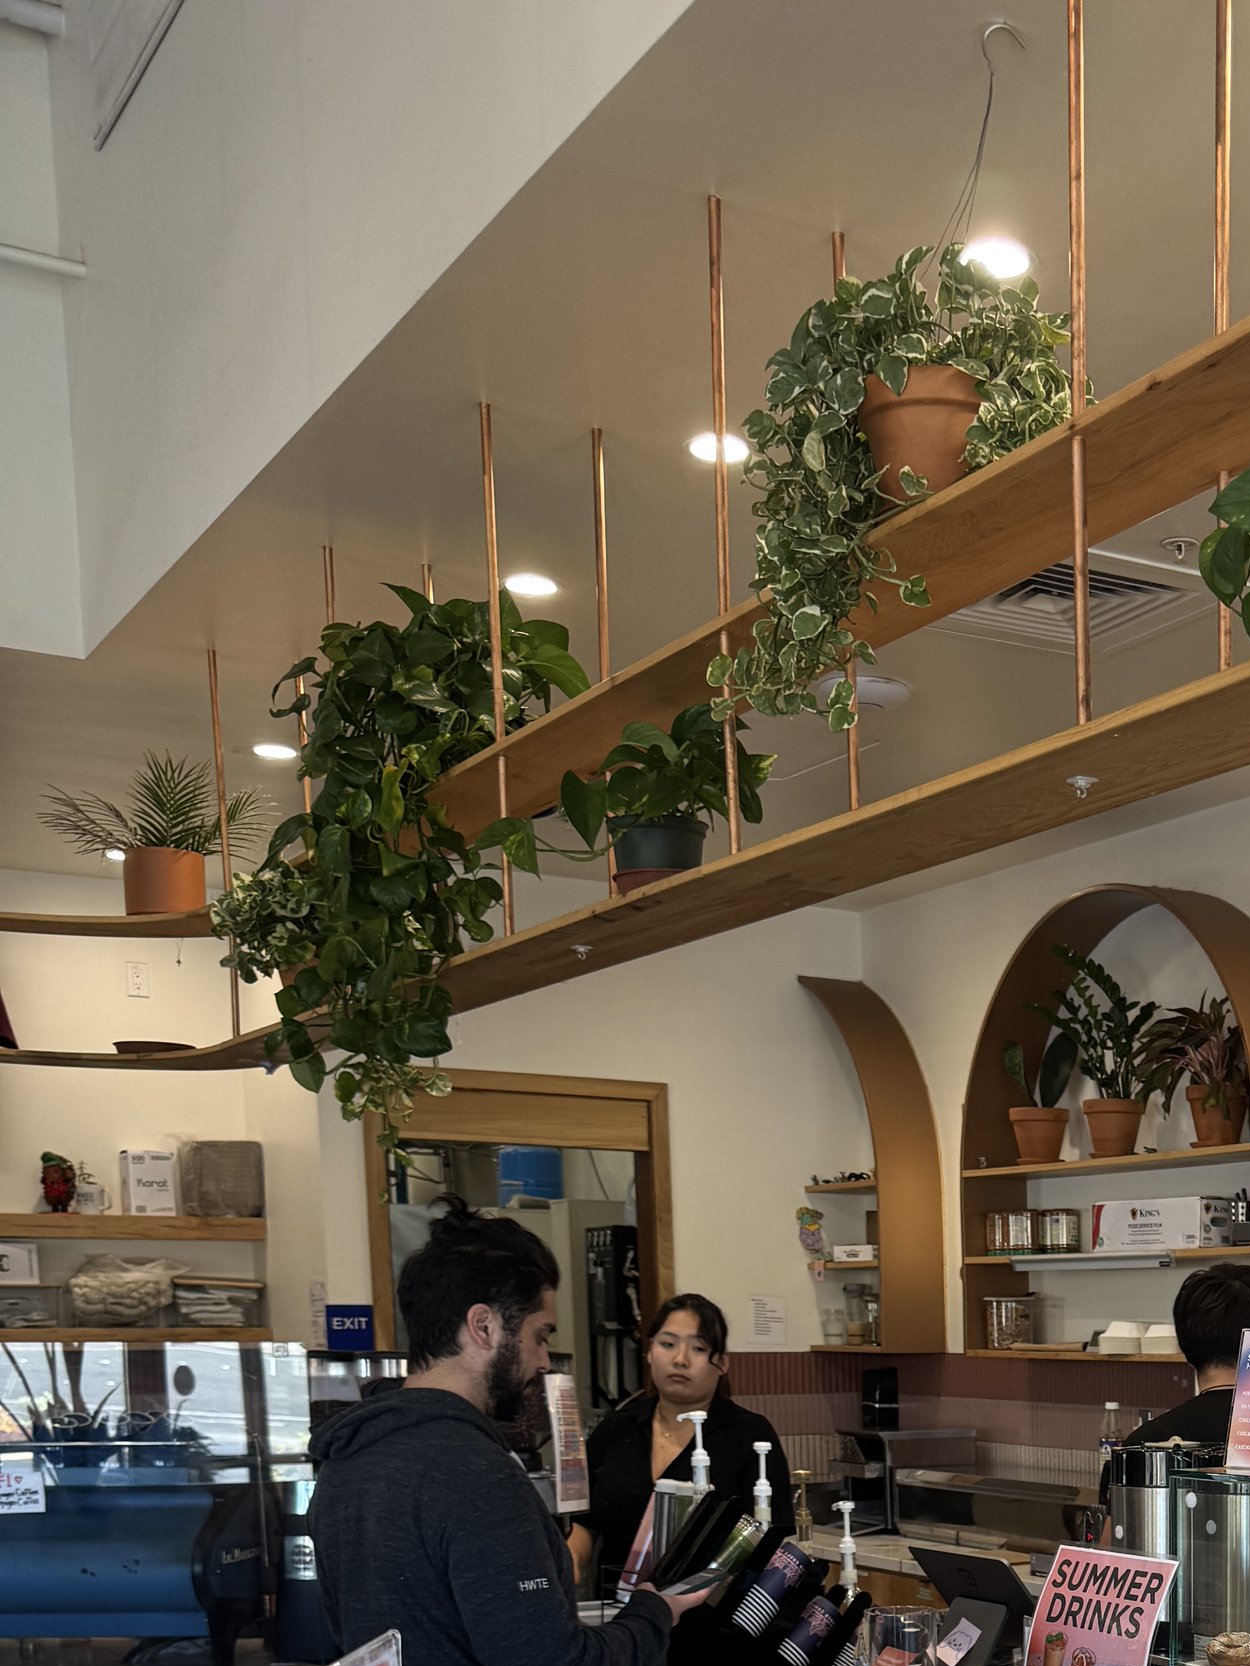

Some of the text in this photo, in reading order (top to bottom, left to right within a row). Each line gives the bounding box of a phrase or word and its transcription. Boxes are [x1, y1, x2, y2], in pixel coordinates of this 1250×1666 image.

[136, 1177, 169, 1189] Karat
[332, 1317, 368, 1330] EXIT
[519, 1578, 550, 1591] HWTE
[1051, 1559, 1164, 1605] SUMMER
[1045, 1592, 1145, 1639] DRINKS
